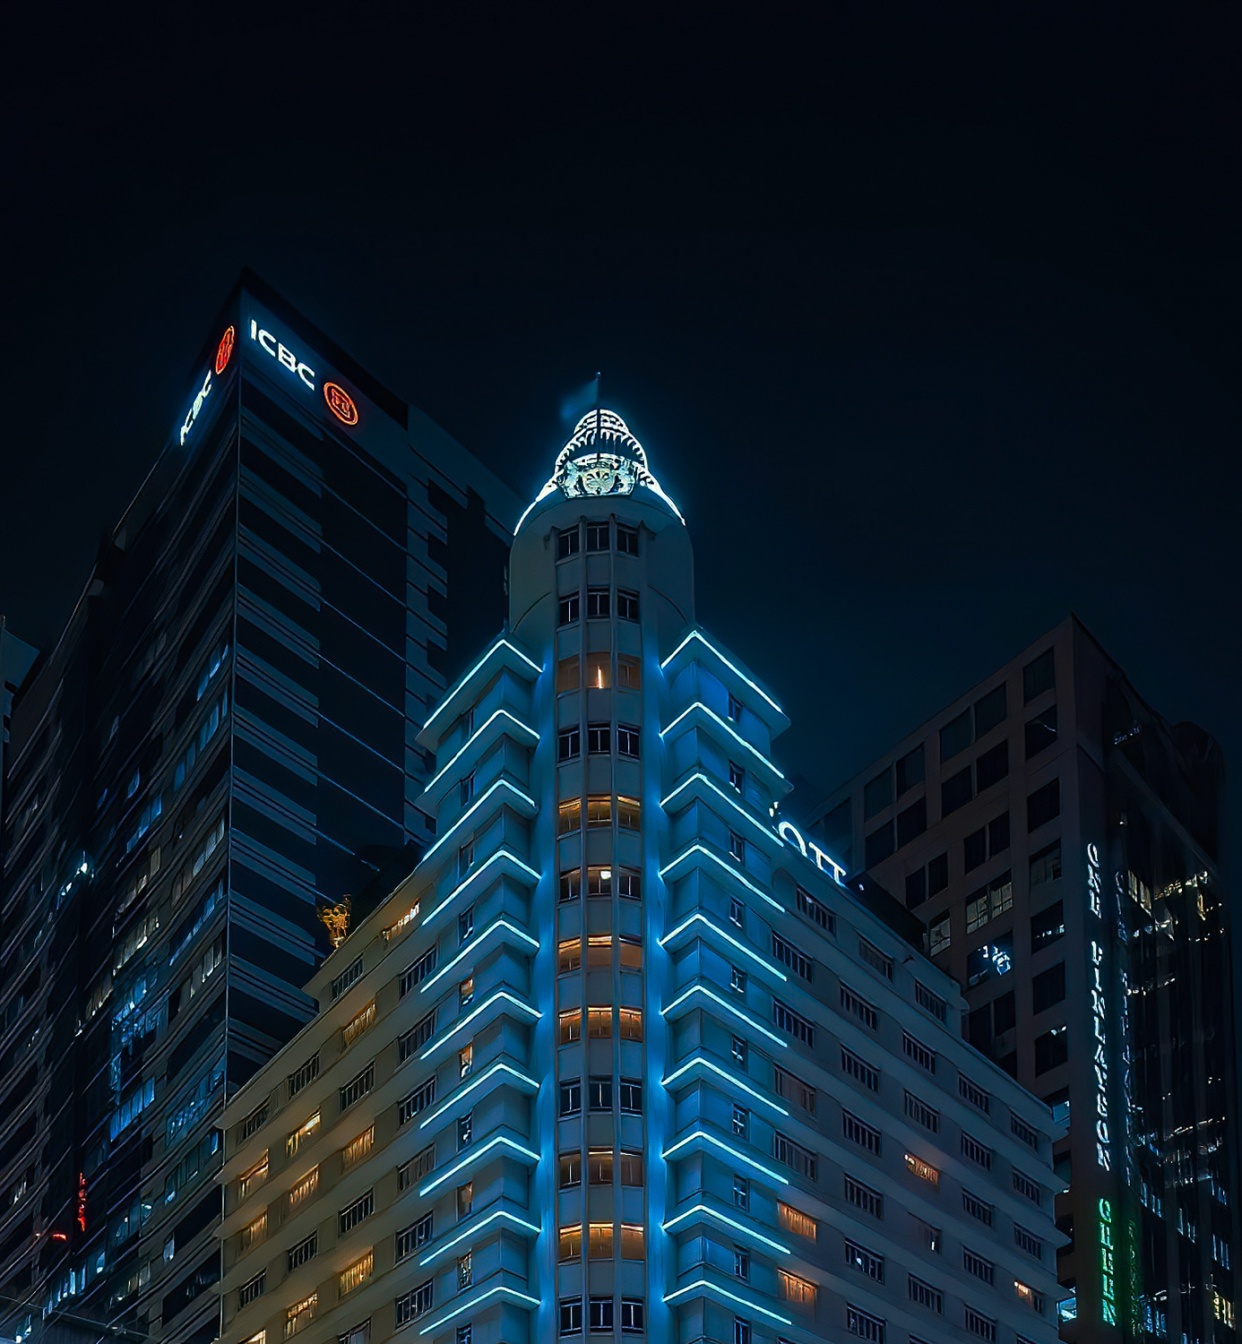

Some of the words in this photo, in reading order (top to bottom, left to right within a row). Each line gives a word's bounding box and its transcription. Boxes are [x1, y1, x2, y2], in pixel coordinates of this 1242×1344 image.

[250, 319, 316, 391] ICBC
[180, 368, 213, 447] ICBC
[767, 800, 848, 888] OTT
